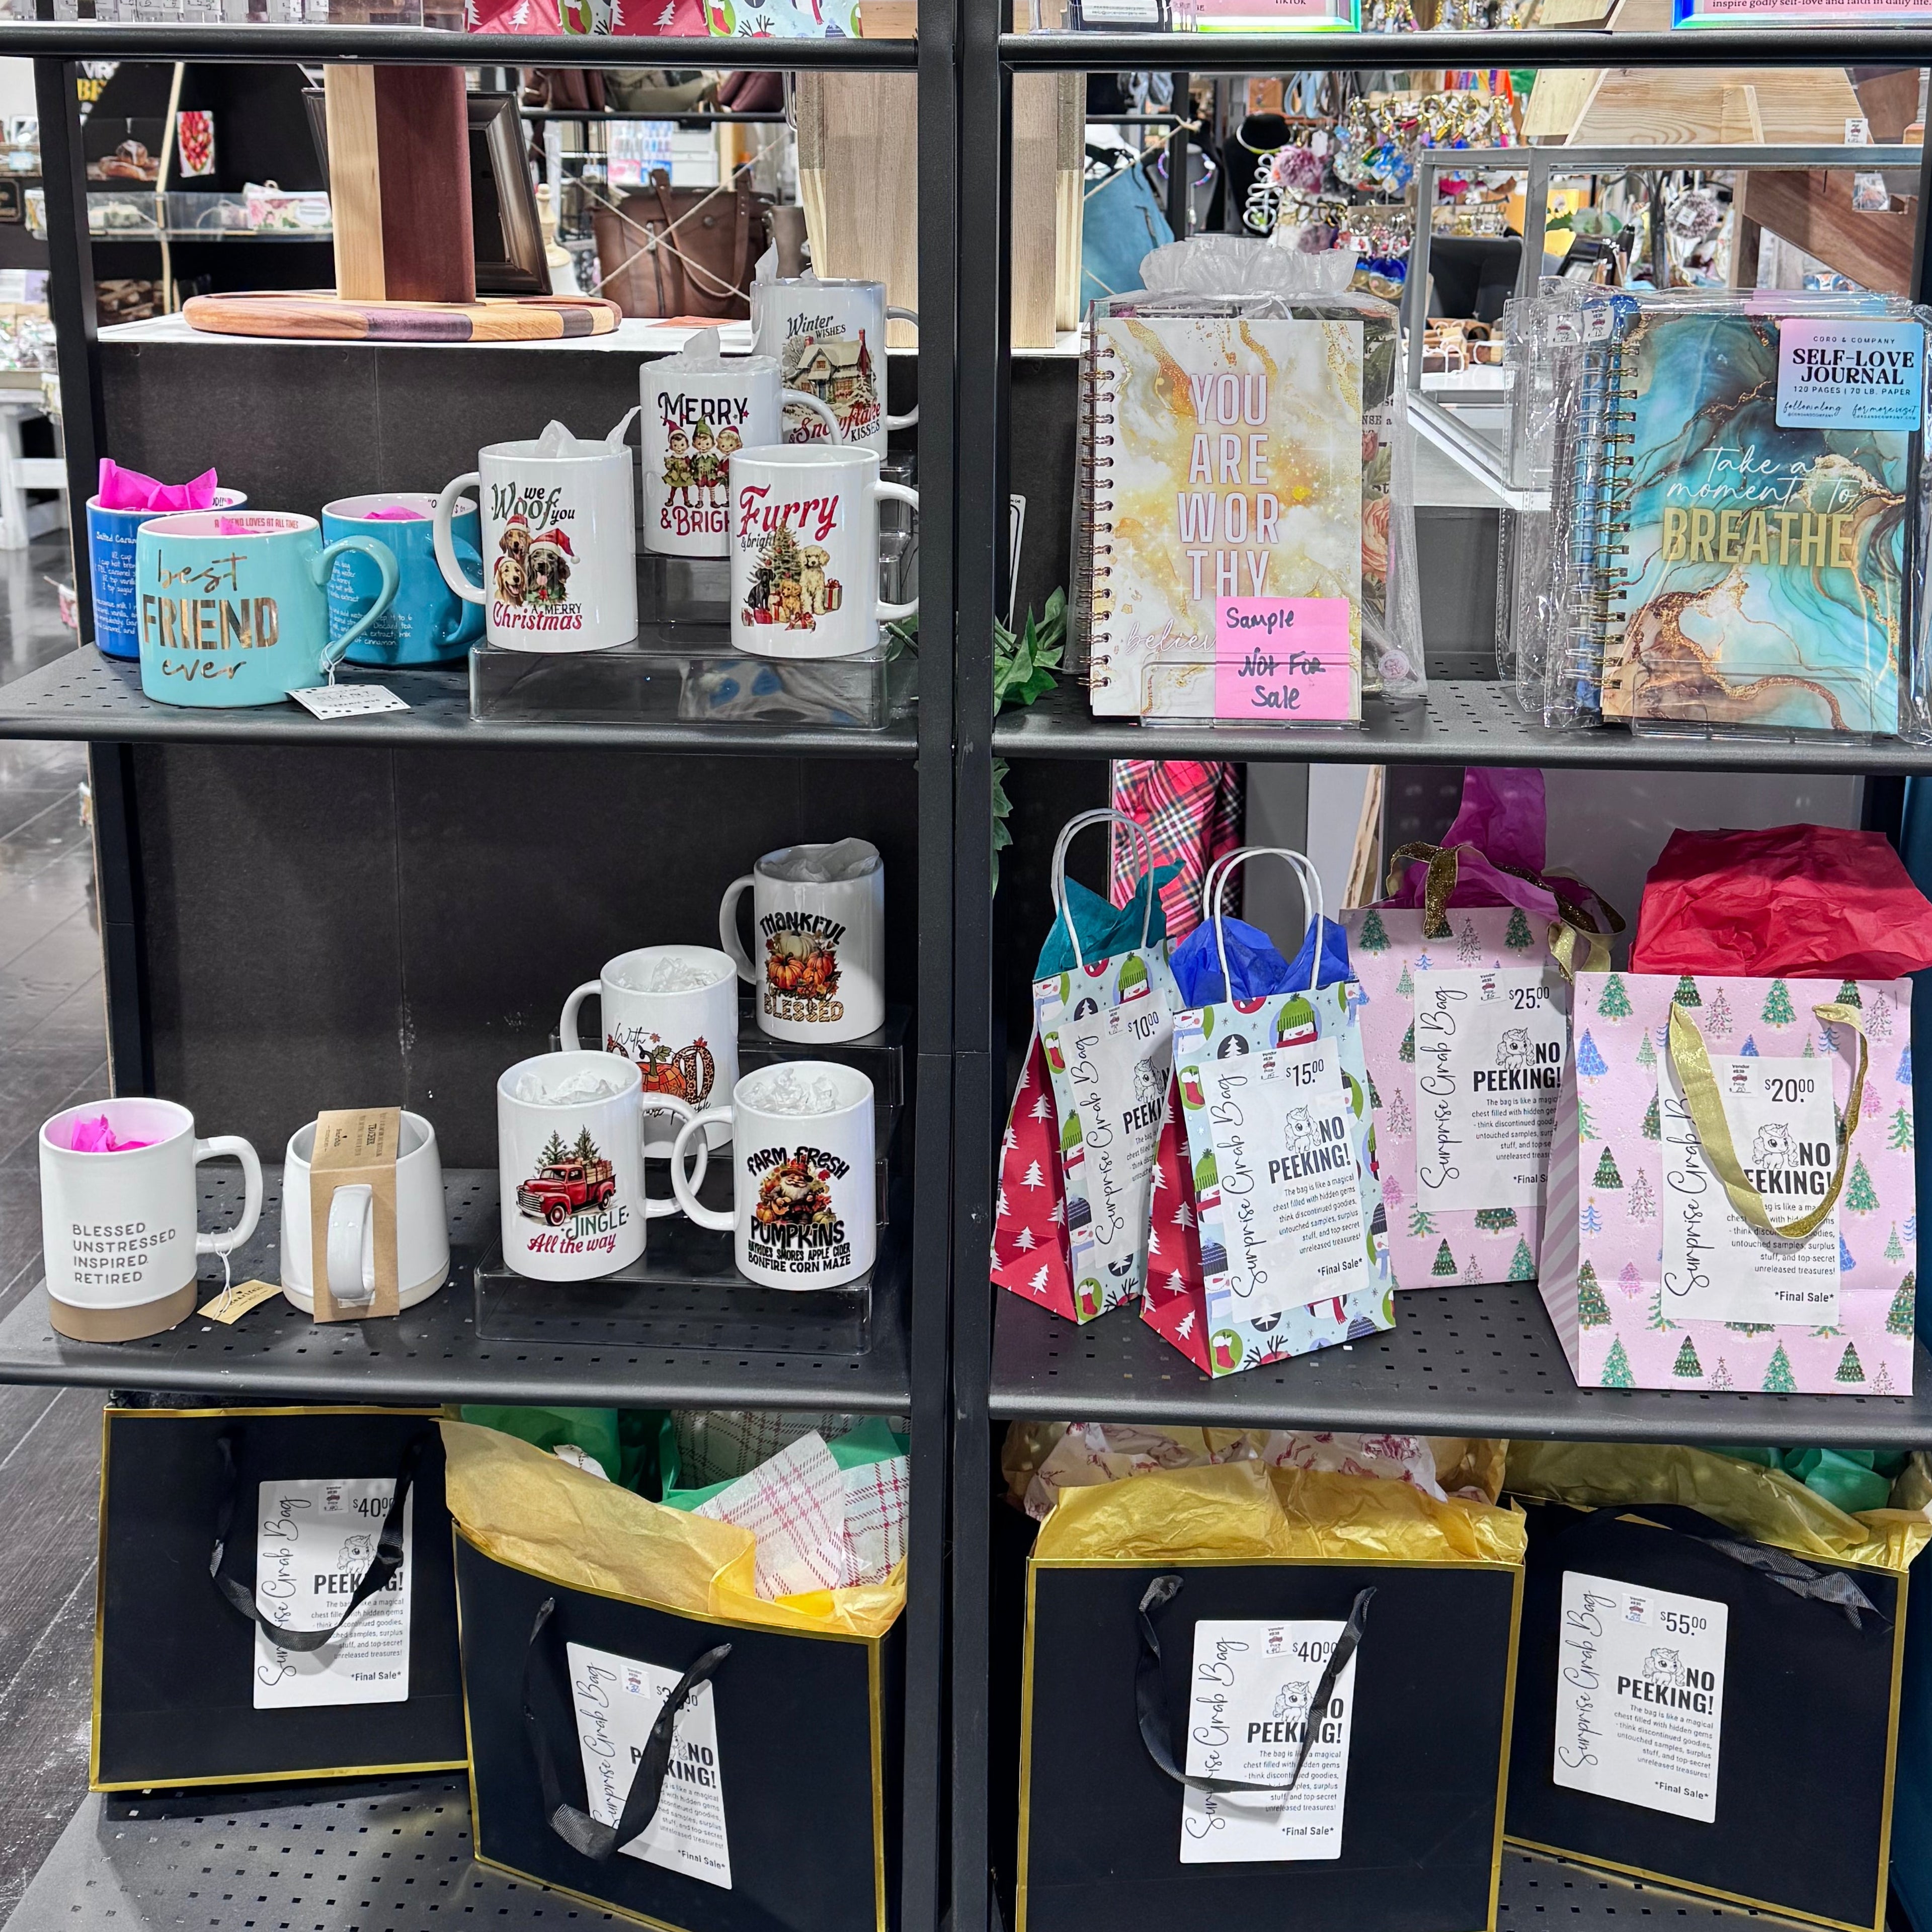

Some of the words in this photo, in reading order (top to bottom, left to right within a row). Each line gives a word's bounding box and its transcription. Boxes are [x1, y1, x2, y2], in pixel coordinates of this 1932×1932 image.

[1713, 0, 1747, 9] inspire
[1749, 0, 1777, 9] godly
[786, 313, 834, 340] Winter
[816, 325, 846, 339] WISHES
[1792, 348, 1914, 368] SELF-LOVE
[1801, 366, 1904, 385] JOURNAL
[658, 392, 748, 427] MERRY
[1189, 373, 1268, 426] YOU
[851, 420, 880, 442] KISSES
[1188, 433, 1269, 485] ARE
[1703, 444, 1780, 482] Take
[1791, 460, 1815, 475] a
[491, 481, 562, 530] Woof
[524, 487, 545, 499] we
[1666, 477, 1812, 511] moment
[1822, 478, 1863, 513] to
[246, 518, 265, 526] LOVES
[267, 519, 274, 527] AT
[276, 519, 284, 528] ALL
[286, 519, 298, 529] TIMES
[549, 509, 575, 525] you
[737, 484, 839, 541] Furry
[1177, 491, 1279, 544] WOR
[1662, 506, 1855, 569] BREATHE
[157, 549, 248, 593] best
[1186, 549, 1270, 601] THY
[142, 594, 280, 650] FRIEND
[493, 601, 583, 630] Christmas
[531, 605, 538, 615] A
[545, 603, 582, 615] MERRY
[1226, 606, 1295, 636] Sample
[162, 658, 247, 681] ever
[1238, 648, 1280, 678] Not
[1251, 684, 1302, 710] Sale
[759, 911, 846, 945] THANKFUL
[764, 993, 844, 1023] BLESSED
[1420, 986, 1467, 1036] Bag
[1071, 1035, 1099, 1084] Bag
[1536, 1042, 1560, 1064] NO
[1420, 1041, 1456, 1096] Grab
[1473, 1067, 1561, 1092] PEEKING!
[1080, 1092, 1113, 1149] Grab
[1320, 1115, 1345, 1143] NO
[1420, 1099, 1463, 1188] Surprise
[1799, 1142, 1831, 1167] NO
[1268, 1143, 1351, 1184] PEEKING!
[1095, 1151, 1124, 1245] Surprise
[527, 1233, 558, 1253] All
[559, 1236, 584, 1254] the
[587, 1233, 616, 1254] way
[808, 1247, 830, 1261] APPLE
[833, 1242, 851, 1257] CIDER
[748, 1251, 786, 1272] BONFIRE
[789, 1261, 820, 1273] CORN
[823, 1253, 851, 1271] MAZE
[1686, 1667, 1715, 1692] NO
[1618, 1675, 1714, 1715] PEEKING!
[1614, 1711, 1632, 1721] chest
[1635, 1715, 1651, 1725] filled
[1653, 1720, 1667, 1729] with
[1669, 1723, 1692, 1734] hidden
[1694, 1730, 1713, 1739] gems
[1630, 1704, 1642, 1713] The
[1644, 1708, 1657, 1717] bag
[1666, 1713, 1678, 1721] like
[1686, 1718, 1713, 1729] magical
[1617, 1732, 1652, 1745] untouched
[1654, 1741, 1684, 1754] samples,
[1686, 1748, 1711, 1759] surplus
[1620, 1722, 1636, 1731] think
[1638, 1726, 1681, 1742] discontinued
[1683, 1737, 1712, 1750] goodies,
[686, 1742, 714, 1766] NO
[1637, 1756, 1674, 1770] unreleased
[1676, 1765, 1710, 1779] treasures!
[1643, 1748, 1660, 1758] stuff,
[1662, 1752, 1674, 1761] and
